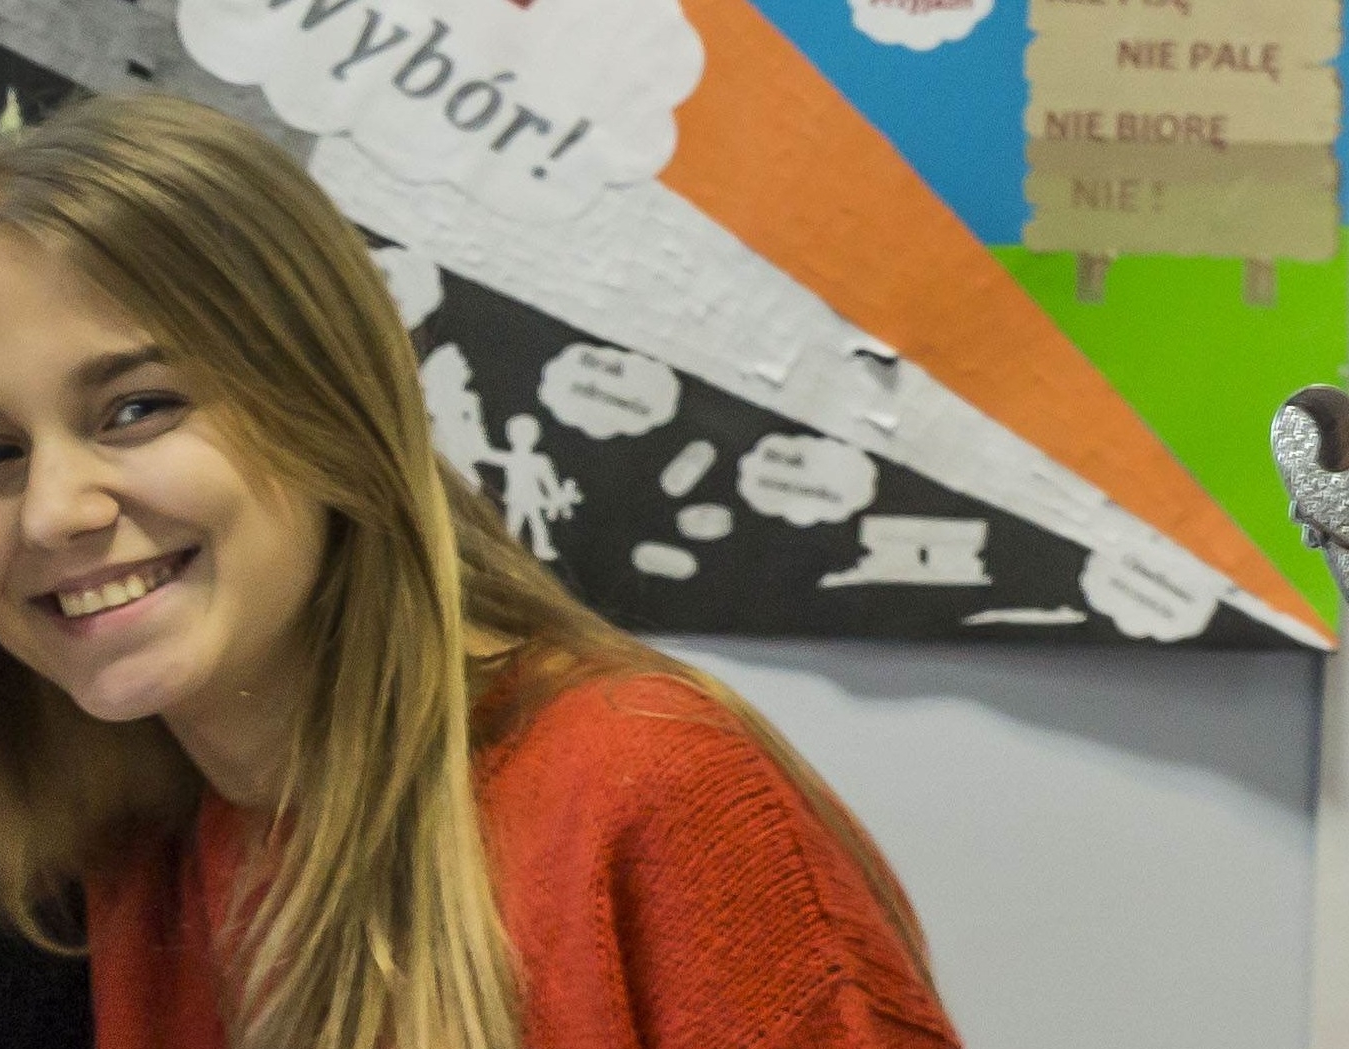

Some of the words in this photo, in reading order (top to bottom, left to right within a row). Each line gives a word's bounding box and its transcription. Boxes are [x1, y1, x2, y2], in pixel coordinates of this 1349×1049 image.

[1117, 40, 1179, 71] NIE
[1189, 42, 1281, 82] PALĘ
[1045, 110, 1103, 142] NIE
[1115, 114, 1230, 151] BIORĘ
[1071, 178, 1142, 212] NIE
